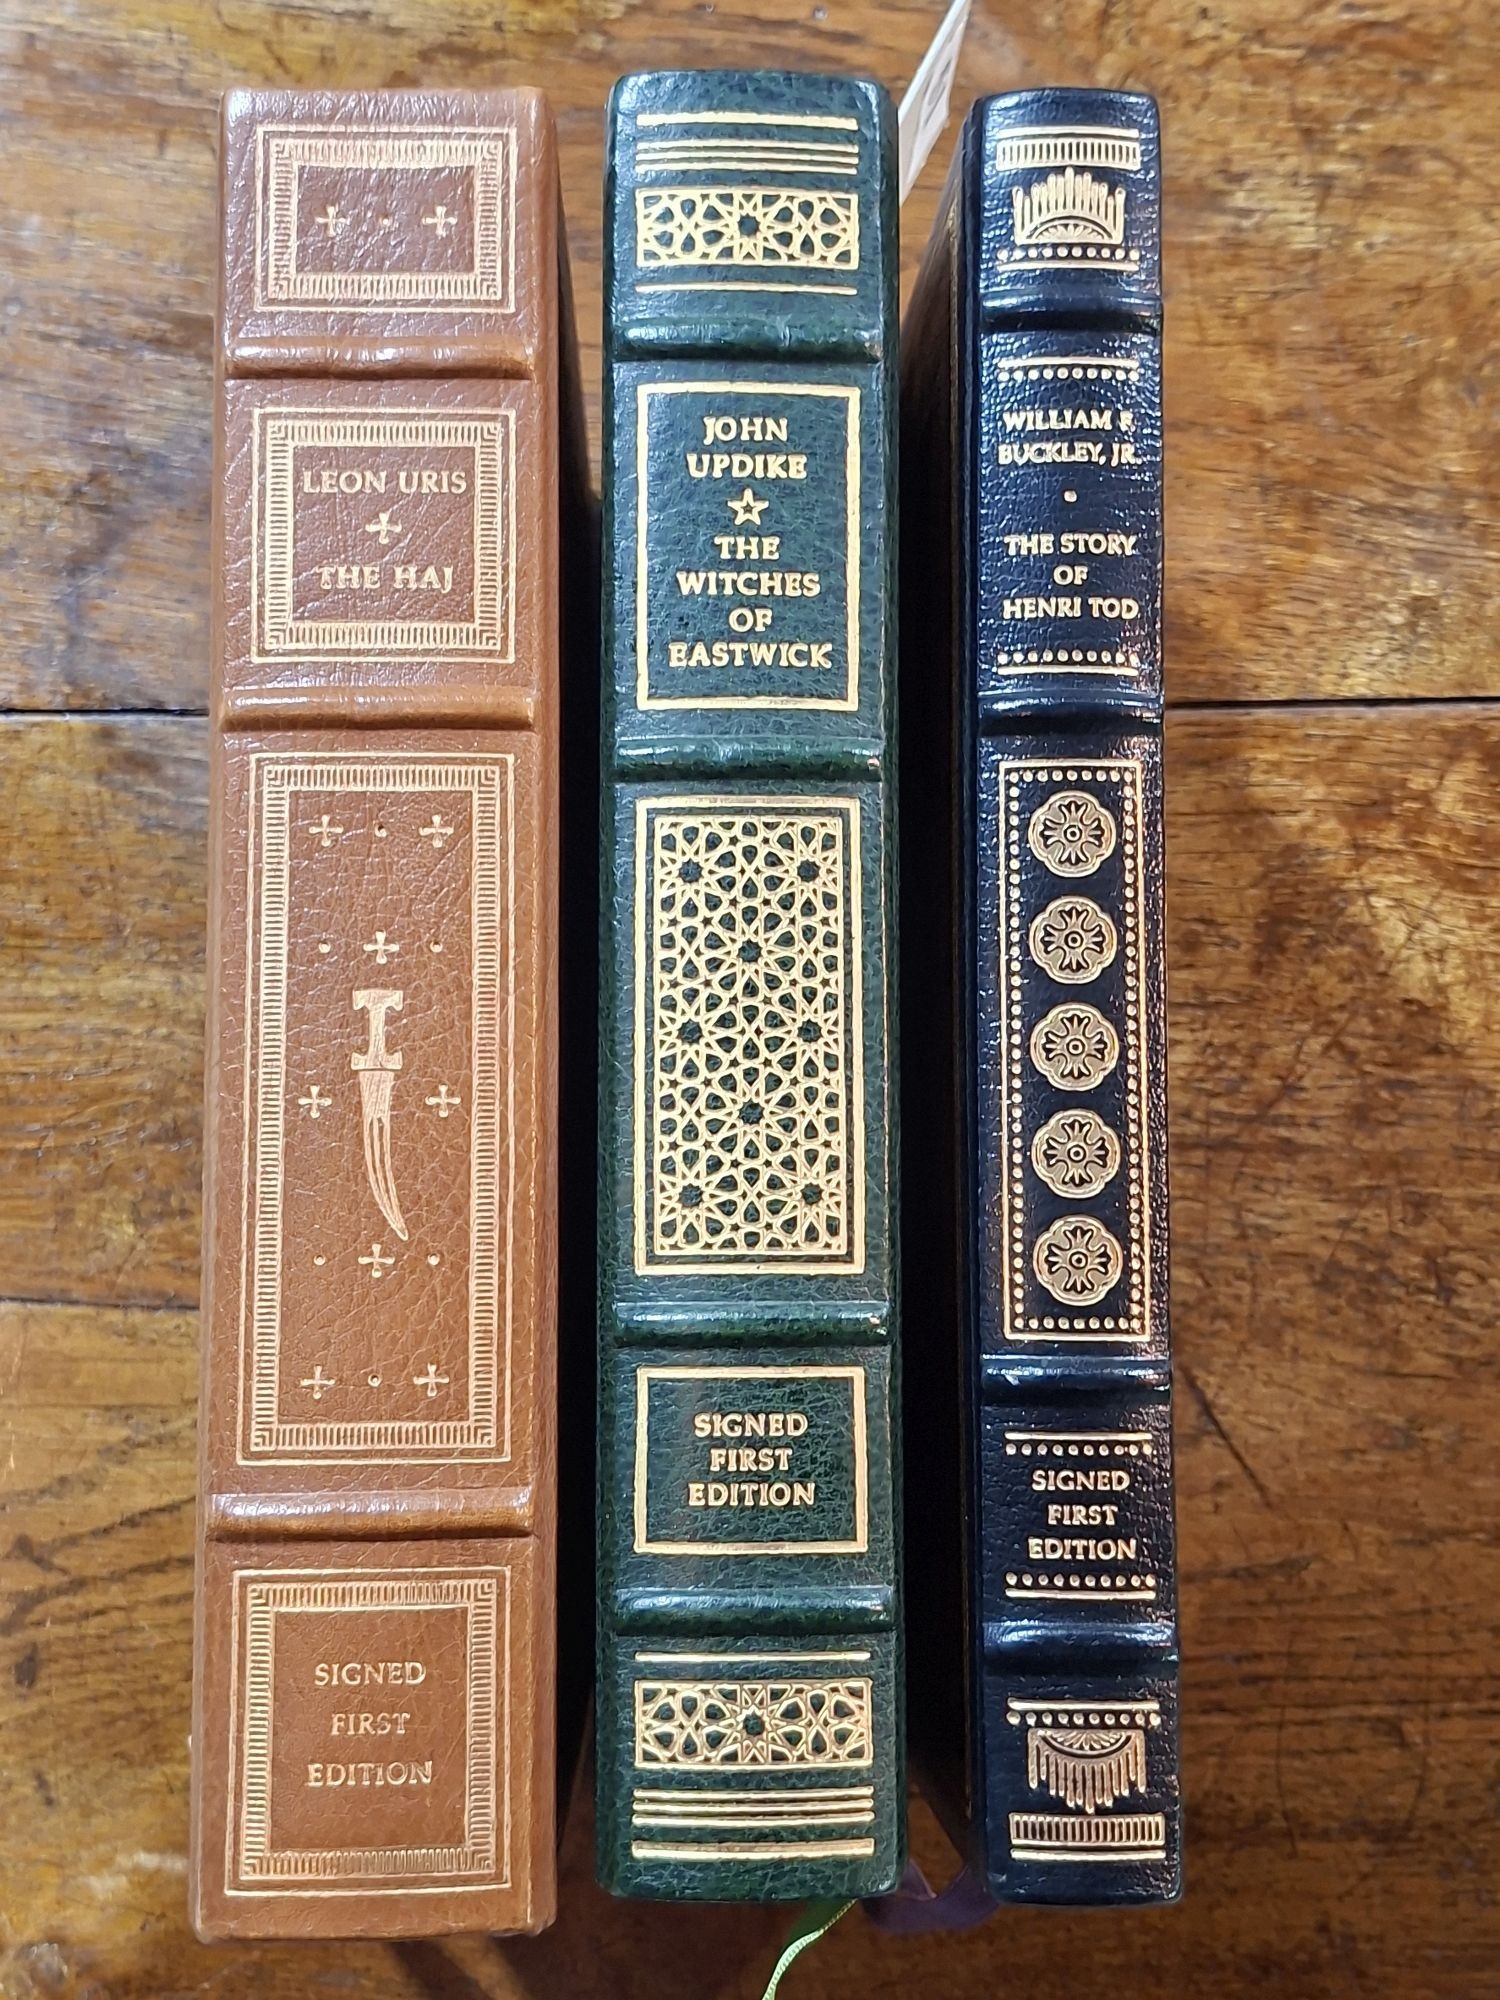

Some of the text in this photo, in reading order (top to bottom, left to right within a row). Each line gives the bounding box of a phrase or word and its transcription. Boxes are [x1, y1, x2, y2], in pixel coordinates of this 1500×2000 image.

[703, 416, 788, 445] JOHN
[1003, 409, 1112, 432] WILLIAM
[686, 453, 807, 479] UPDIKE
[998, 441, 1142, 468] BUCKLEY, JR.
[303, 470, 467, 494] LEON URIS
[714, 536, 780, 560] THE
[1004, 533, 1136, 556] THE STORY
[316, 565, 454, 593] THE HAJ
[676, 571, 821, 597] WITCHES
[1053, 565, 1088, 585] OF
[728, 607, 773, 632] OF
[1003, 597, 1139, 620] HENRI TOD
[668, 642, 833, 669] EASTWICK
[694, 1412, 808, 1437] SIGNED
[710, 1447, 793, 1471] FIRST
[1032, 1469, 1130, 1491] SIGNED
[688, 1482, 816, 1507] EDITION
[1047, 1504, 1118, 1525] FIRST
[1028, 1537, 1137, 1560] EDITION
[314, 1661, 426, 1686] SIGNED
[331, 1712, 410, 1735] FIRST
[305, 1760, 432, 1787] EDITION
